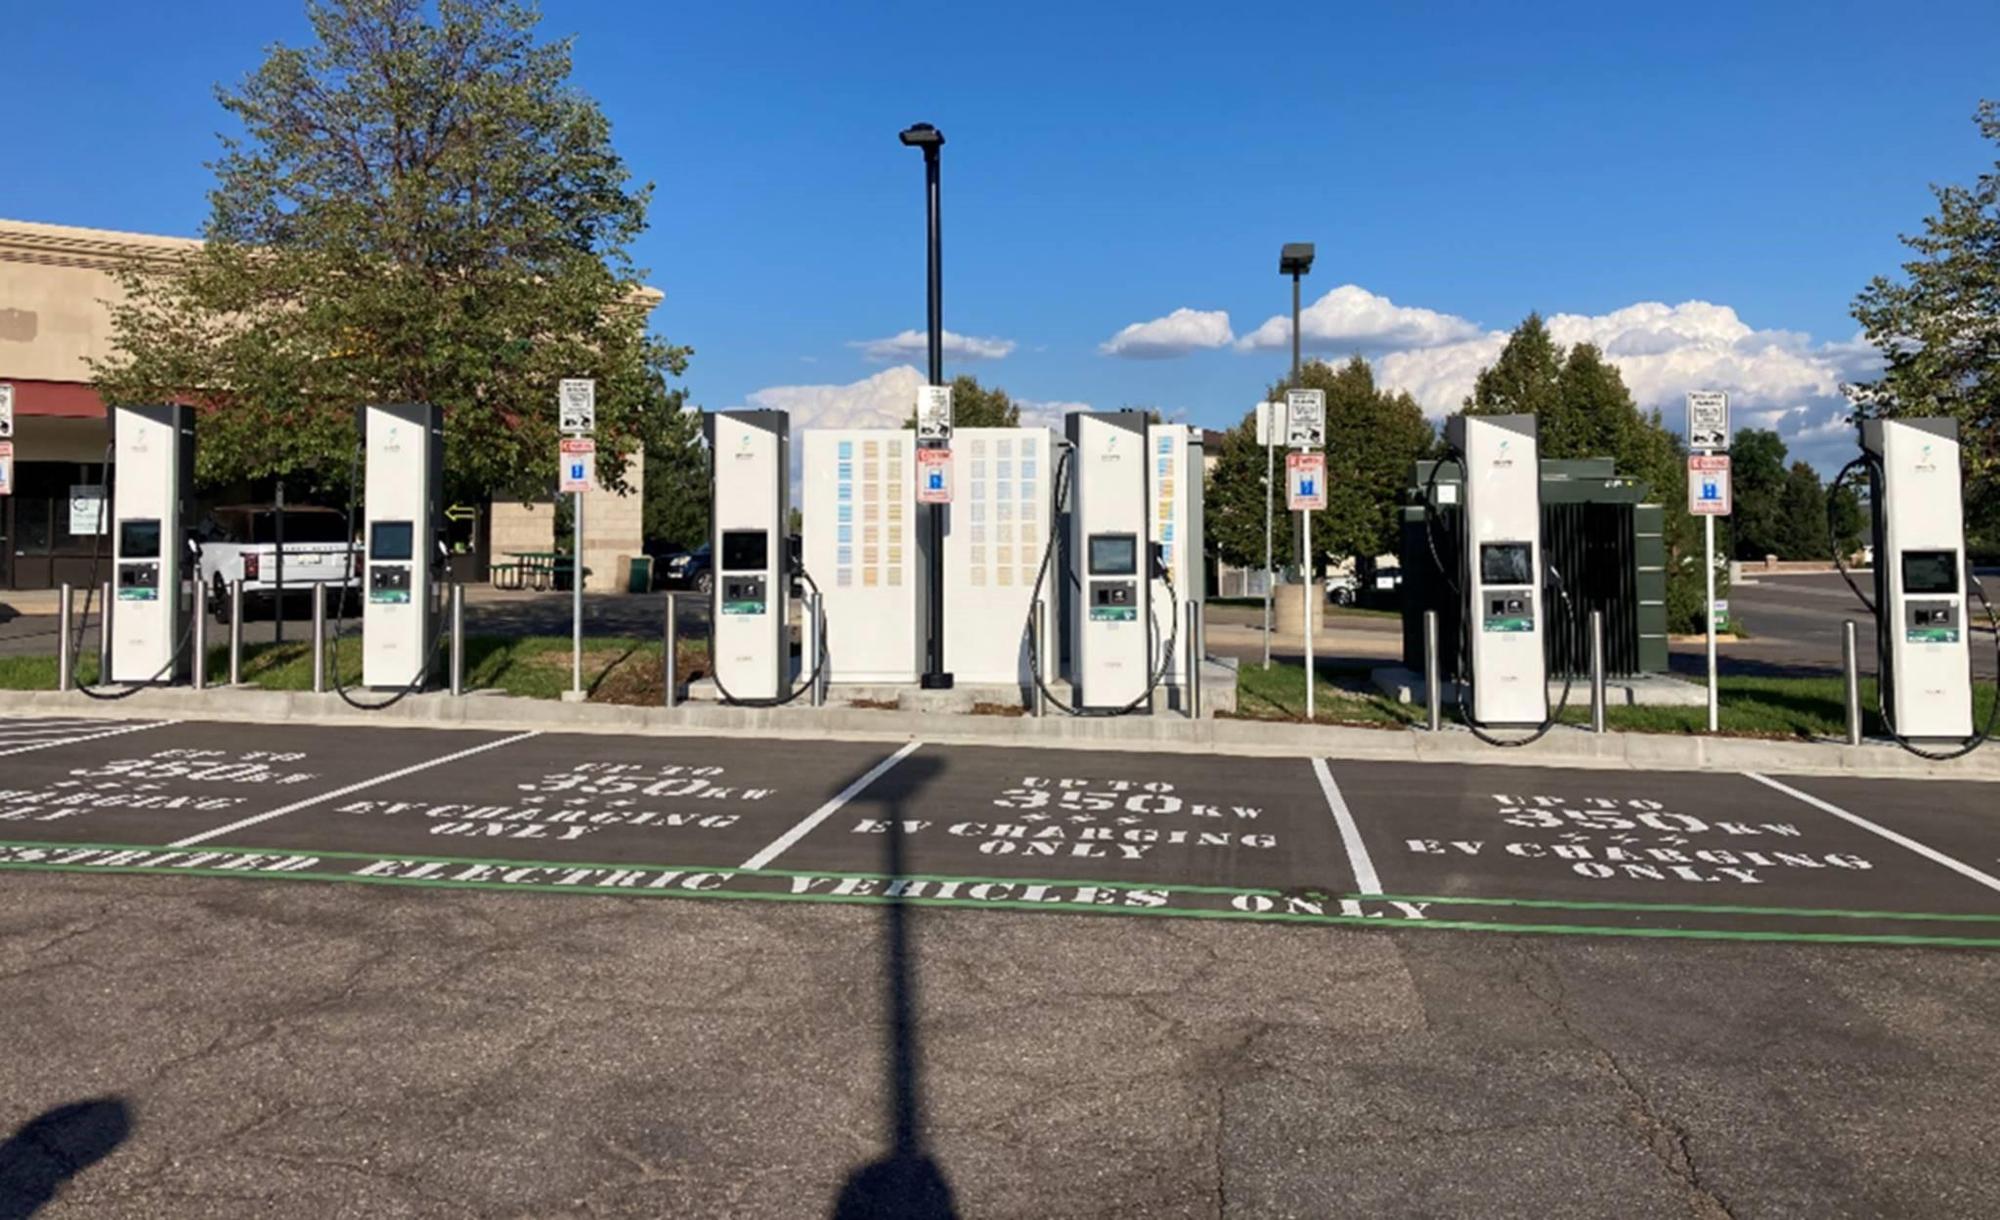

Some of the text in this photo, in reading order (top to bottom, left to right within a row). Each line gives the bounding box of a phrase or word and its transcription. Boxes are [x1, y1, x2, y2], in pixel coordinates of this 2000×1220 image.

[573, 763, 725, 776] UP TO
[1022, 776, 1175, 793] UP TO
[992, 788, 1184, 814] 350
[1491, 793, 1664, 811] UP TO
[333, 801, 741, 827] EV CHARGING
[1498, 808, 1710, 832] 350
[429, 822, 601, 840] ONLY
[851, 818, 1277, 849] EV CHARGING
[978, 839, 1153, 860] ONLY
[1405, 838, 1873, 870] EV CHARGING
[1572, 861, 1765, 884] ONLY
[351, 859, 736, 891] ELECTRIC
[790, 875, 1171, 908] VEHICLES
[1231, 894, 1432, 920] ONLY
